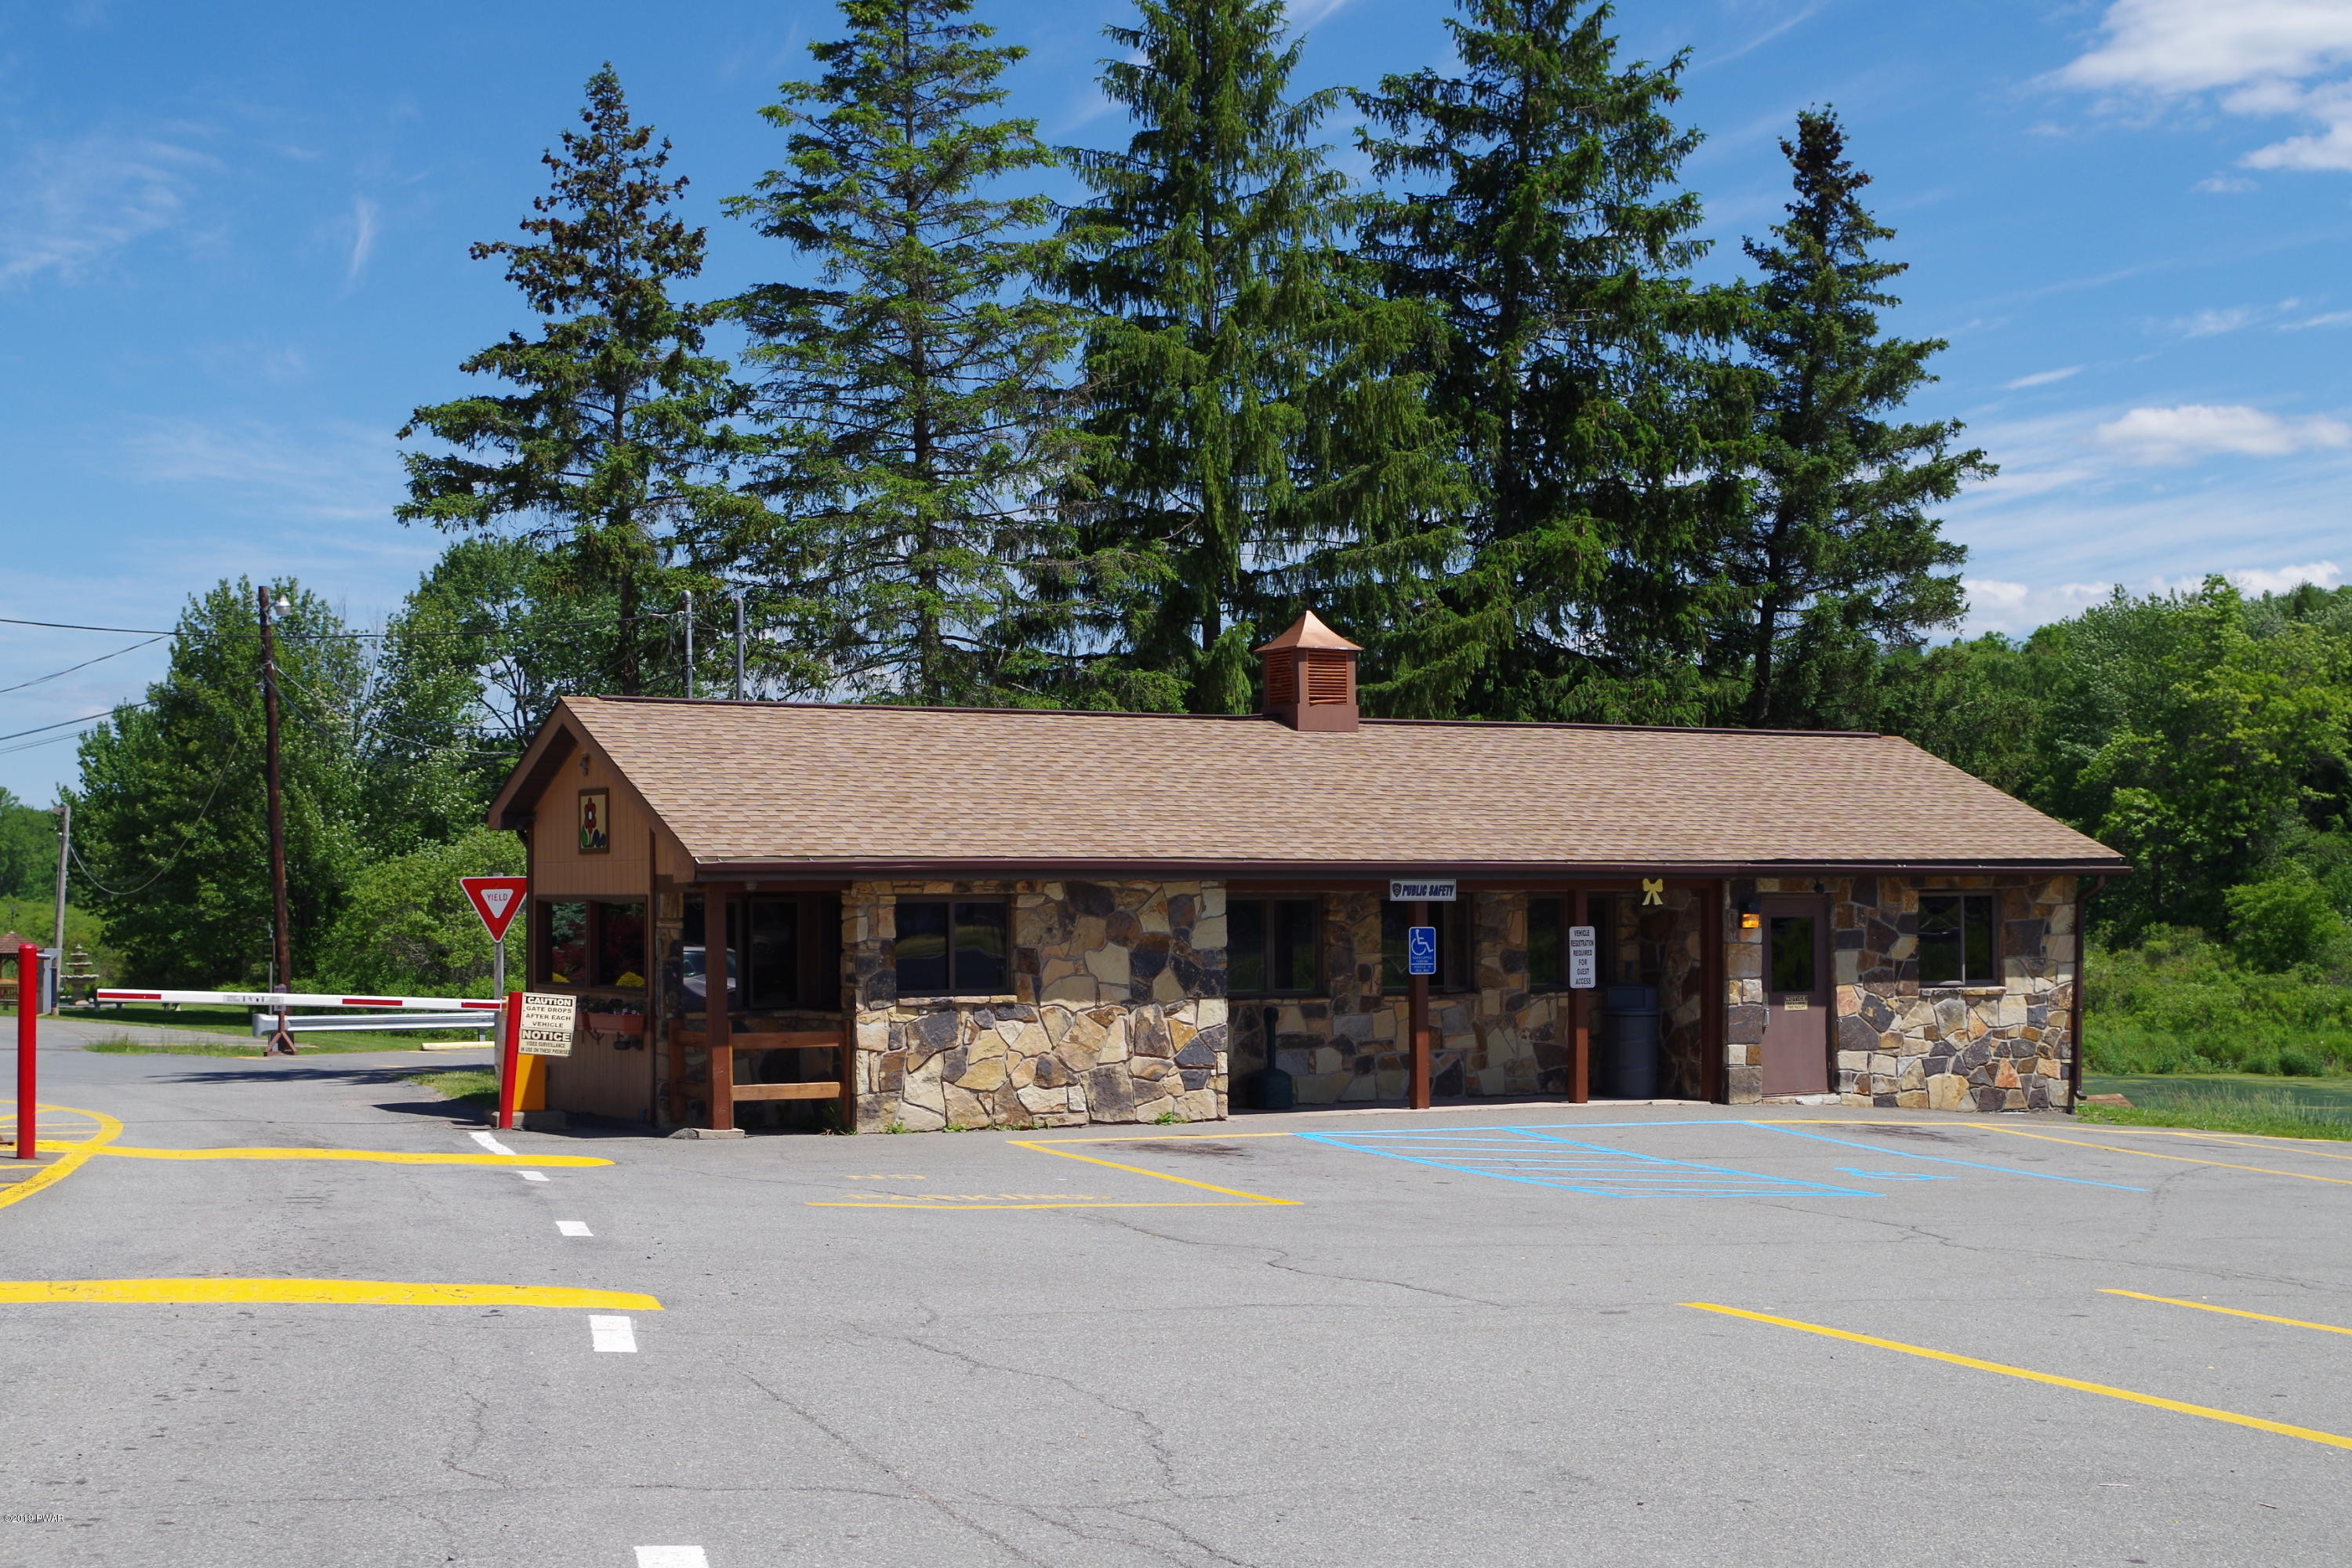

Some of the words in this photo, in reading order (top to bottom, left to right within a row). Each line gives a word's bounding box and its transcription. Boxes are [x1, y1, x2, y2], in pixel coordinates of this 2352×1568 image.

[1402, 884, 1428, 896] PUBLIC
[1428, 884, 1454, 896] SAFETY
[487, 893, 508, 902] YIELD
[527, 996, 572, 1006] CAUTION
[521, 1030, 571, 1041] NOTICE
